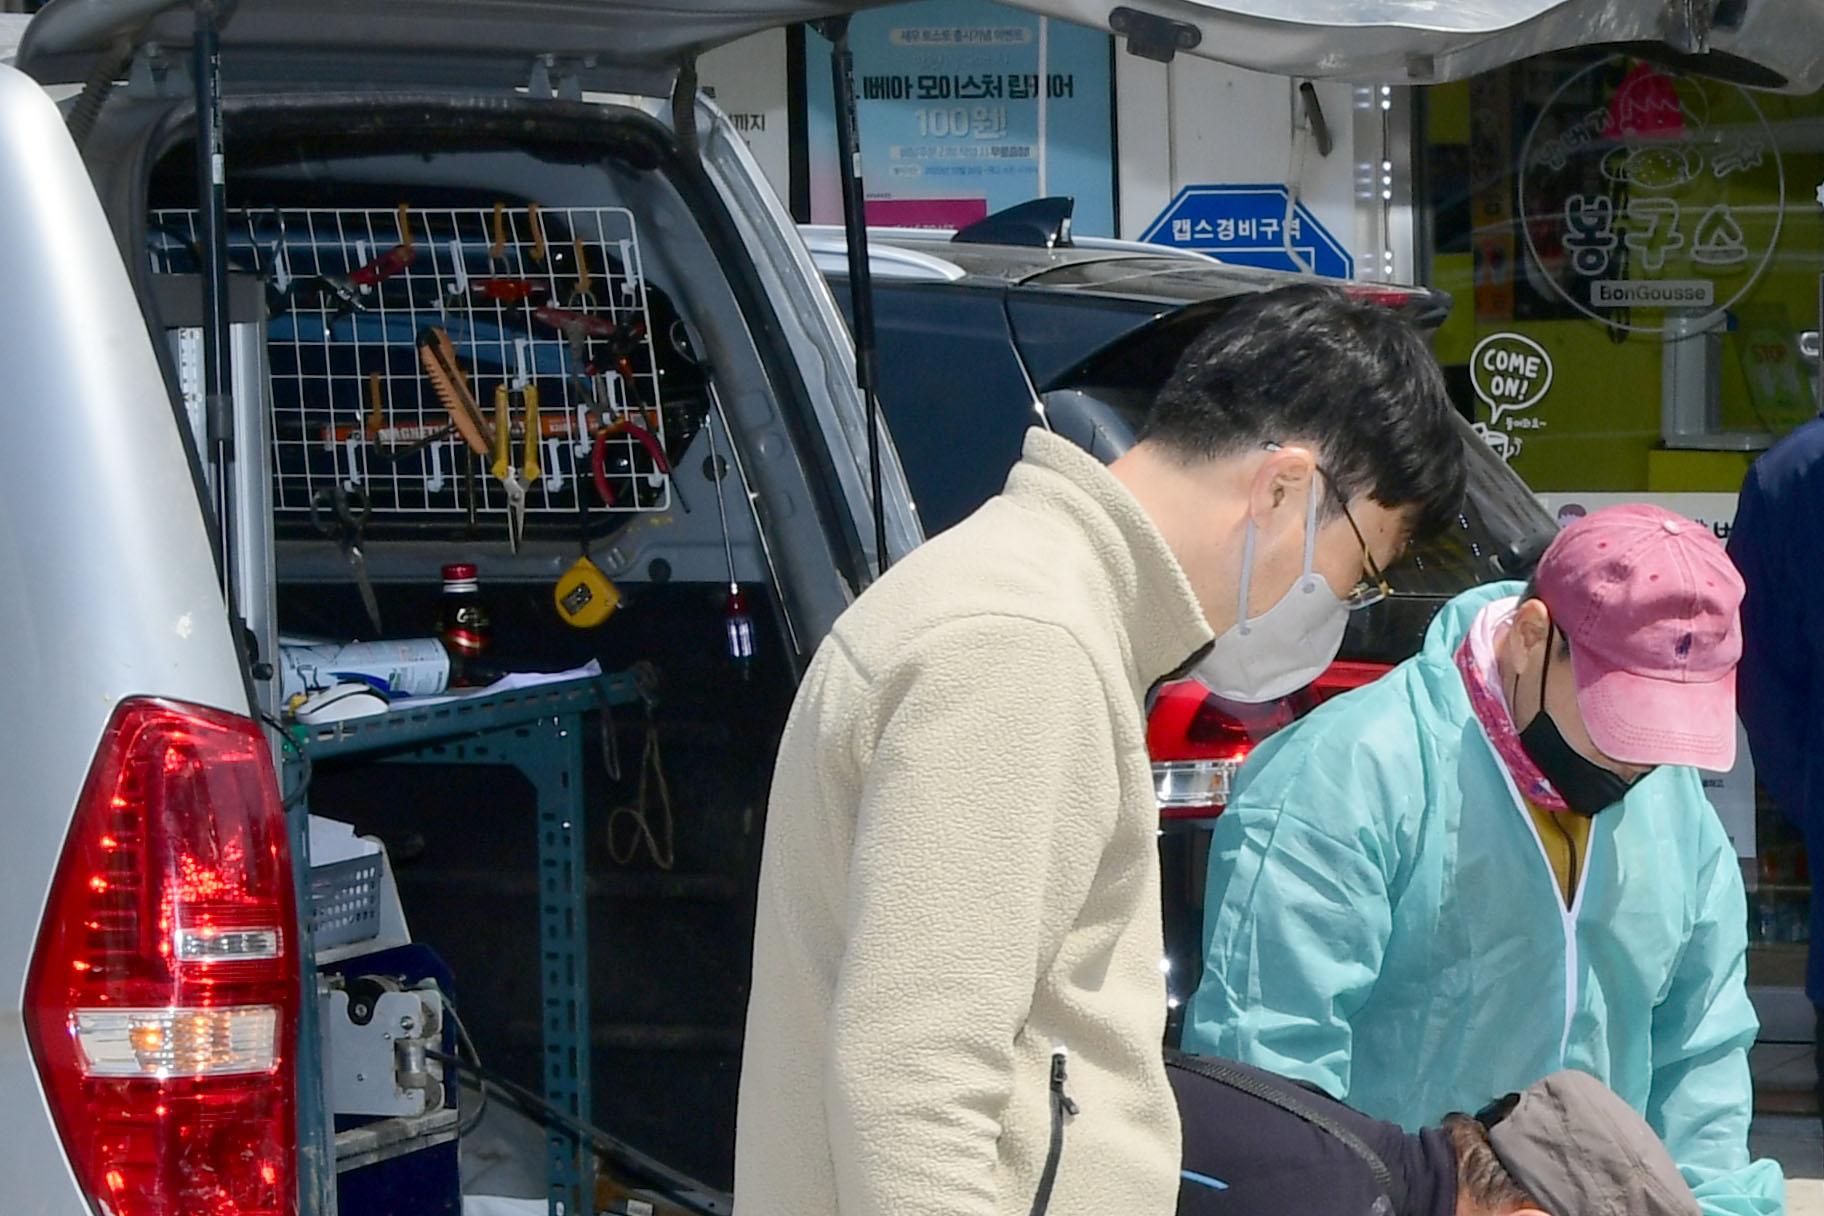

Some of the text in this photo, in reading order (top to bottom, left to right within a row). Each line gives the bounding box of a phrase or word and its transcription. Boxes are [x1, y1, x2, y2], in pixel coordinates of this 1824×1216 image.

[917, 75, 1003, 100] 모이스처
[1599, 284, 1707, 302] BonGousse
[1483, 348, 1541, 378] COME
[1490, 375, 1529, 401] ON!
